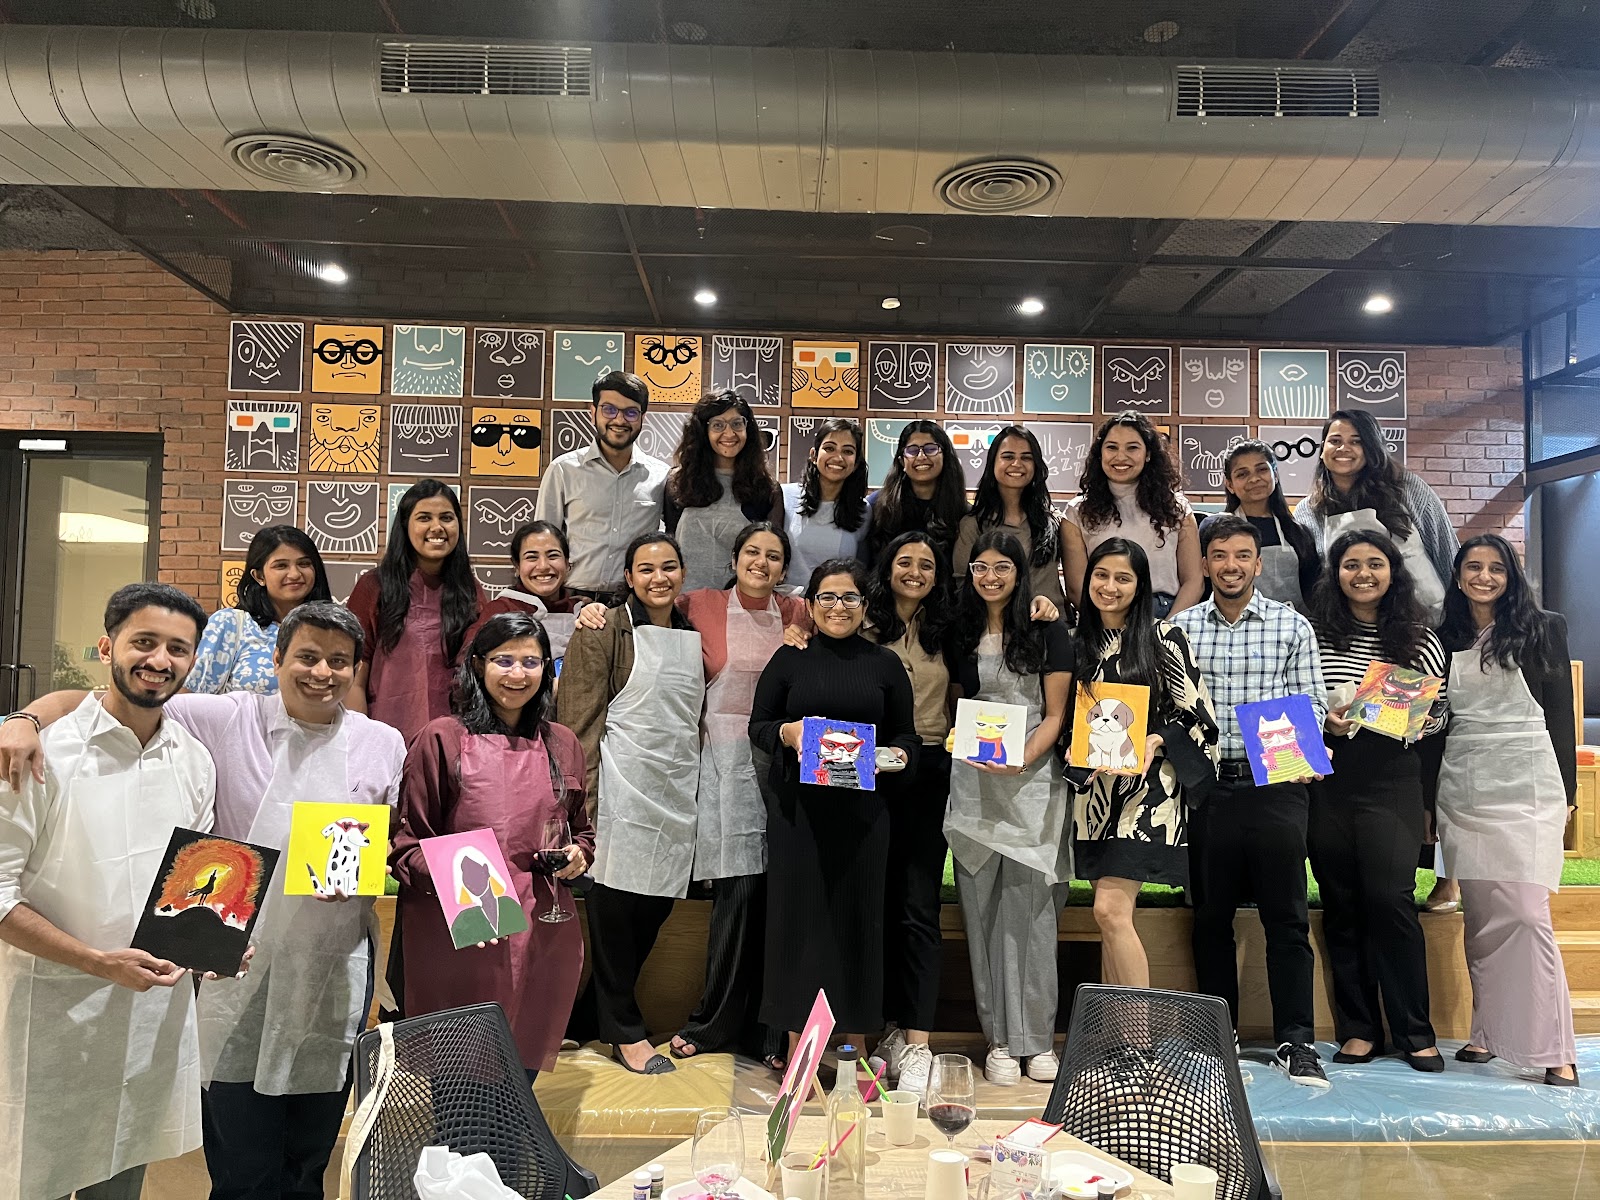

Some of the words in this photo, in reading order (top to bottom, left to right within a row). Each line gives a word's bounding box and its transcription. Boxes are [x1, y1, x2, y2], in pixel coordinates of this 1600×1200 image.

[1075, 444, 1088, 459] Z
[1061, 458, 1072, 471] Z
[1074, 462, 1083, 477] Z
